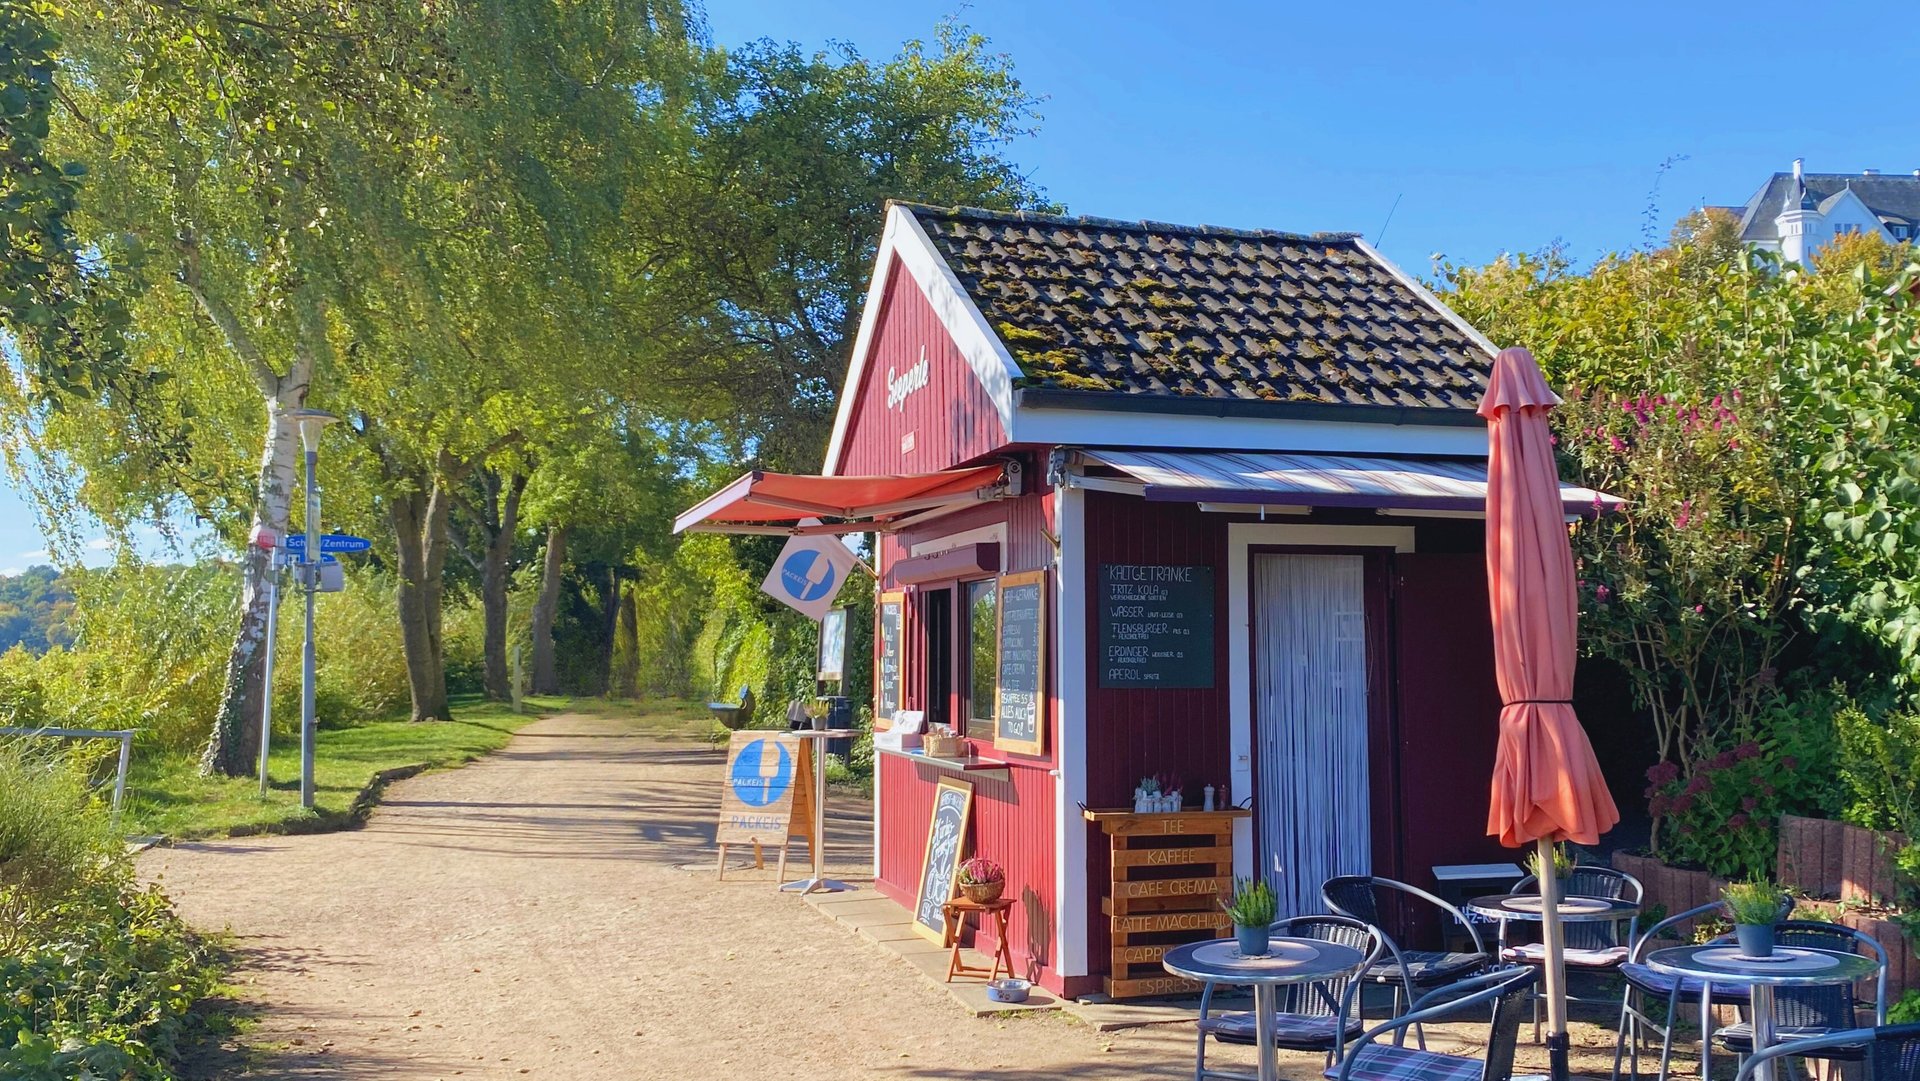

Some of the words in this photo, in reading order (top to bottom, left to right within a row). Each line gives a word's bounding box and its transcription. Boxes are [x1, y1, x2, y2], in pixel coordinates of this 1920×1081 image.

[1138, 584, 1159, 595] KOLA
[1110, 606, 1144, 618] WASSER
[1109, 646, 1149, 657] ERDINGER
[1109, 668, 1141, 680] APEROL
[733, 778, 763, 786] PACKEIS
[731, 816, 781, 830] PACKEIS
[1162, 819, 1184, 833] TEE
[1147, 849, 1195, 864] KAFFEE
[1128, 882, 1163, 896] CAFE
[1170, 880, 1218, 894] CREMA
[1115, 916, 1151, 932] LATTE
[1155, 913, 1233, 930] MACCHIATO
